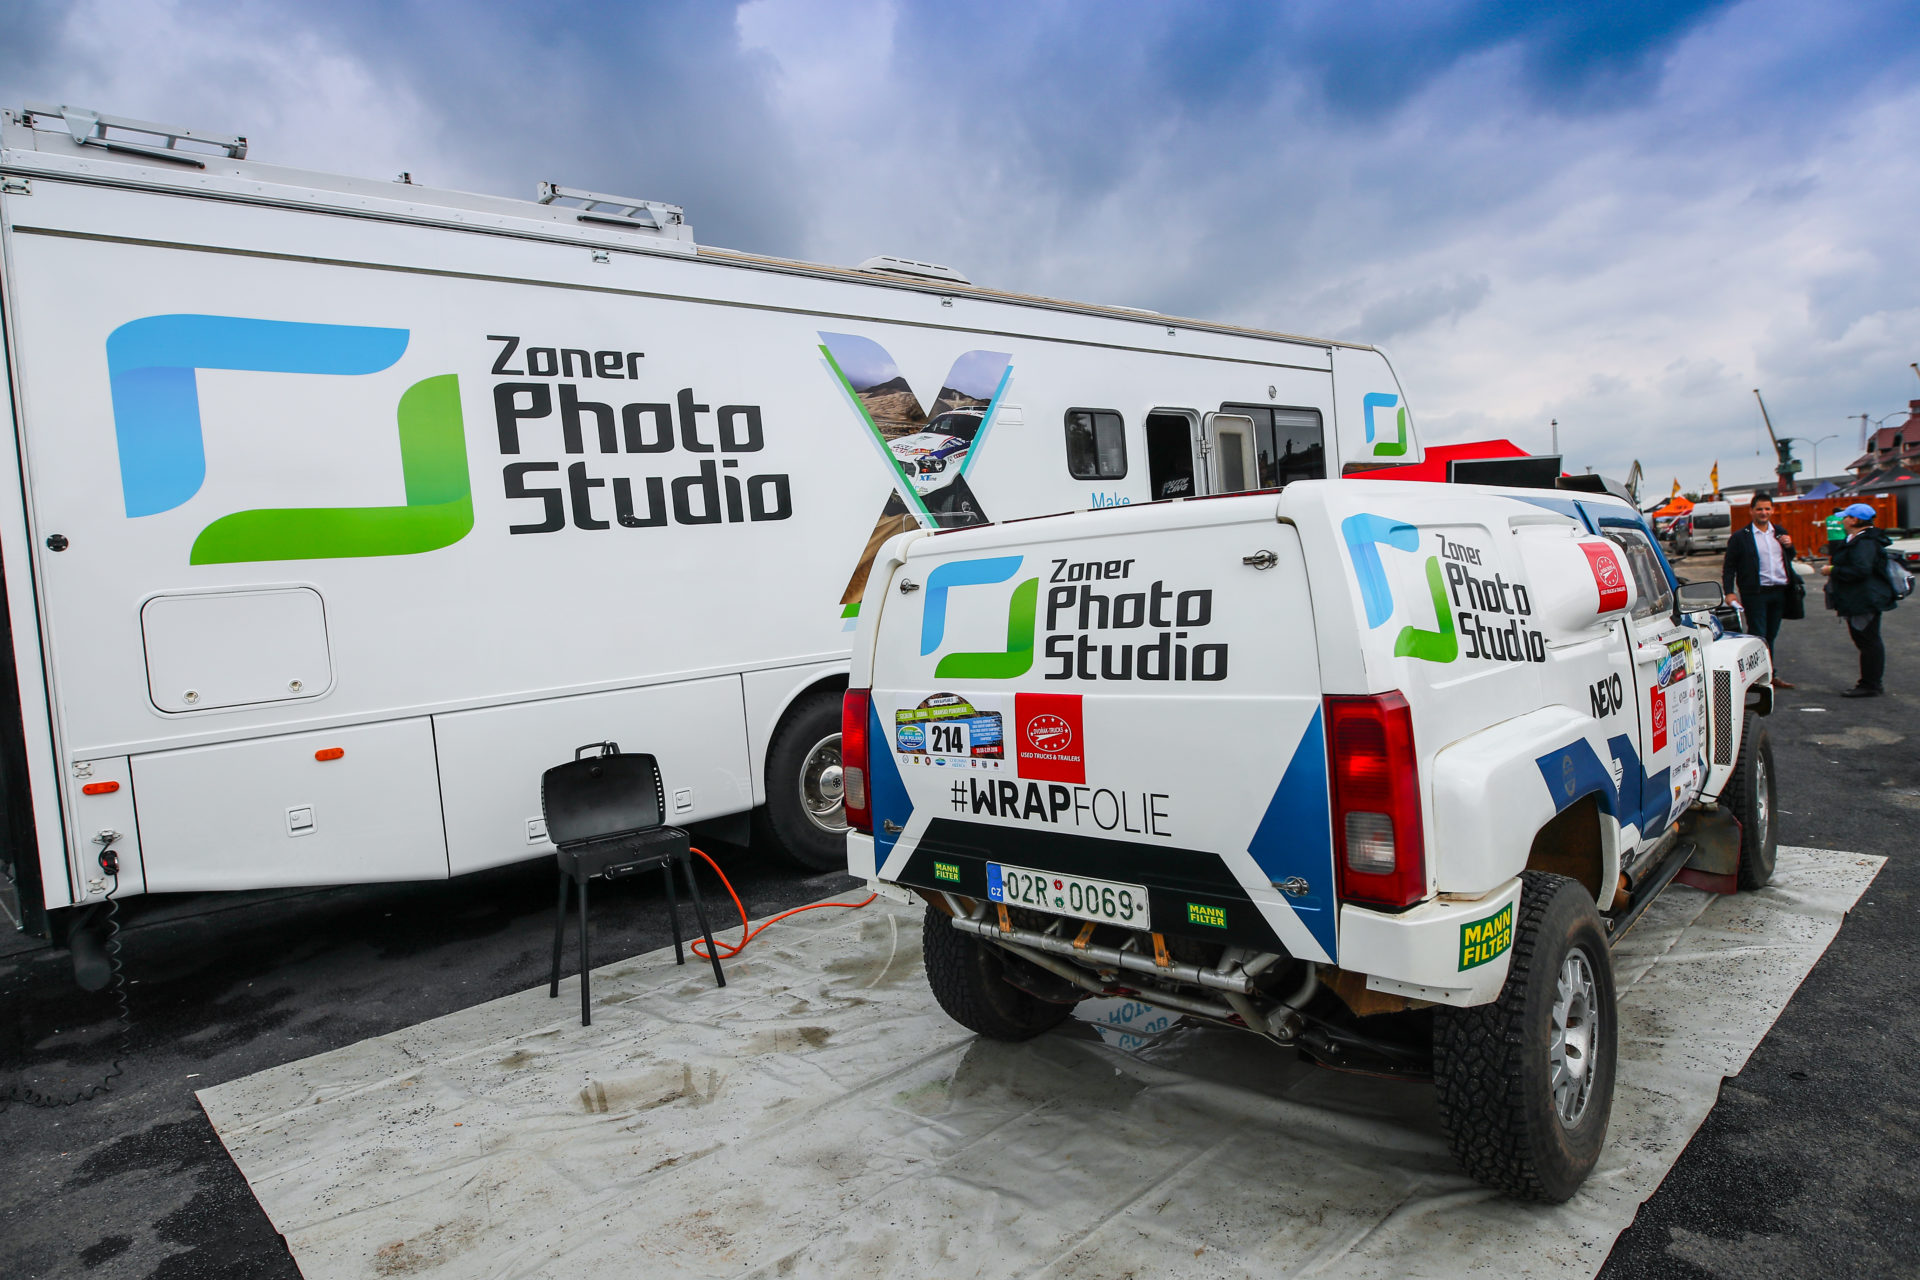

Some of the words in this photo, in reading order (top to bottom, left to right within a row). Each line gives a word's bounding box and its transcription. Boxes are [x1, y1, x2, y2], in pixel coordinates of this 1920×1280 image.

[487, 334, 645, 380] Zoner
[493, 382, 765, 455] Photo
[503, 459, 793, 535] Studio
[1092, 490, 1130, 508] Make
[1436, 534, 1482, 567] Zoner
[1050, 558, 1136, 584] Zoner
[1445, 562, 1532, 616] Photo
[1047, 580, 1213, 629] Photo
[1458, 611, 1546, 663] Studio
[1045, 632, 1229, 682] Studio
[1589, 672, 1623, 719] NEXO
[932, 725, 963, 753] 214
[1058, 754, 1081, 762] TRAILERS
[936, 864, 958, 873] MANN
[936, 870, 959, 881] FILTER
[991, 886, 1002, 897] CZ
[1070, 882, 1134, 921] 0069
[1190, 904, 1224, 918] MANN
[1190, 913, 1225, 926] FILTER
[1464, 908, 1511, 946] MANN
[1463, 928, 1511, 966] FILTER
